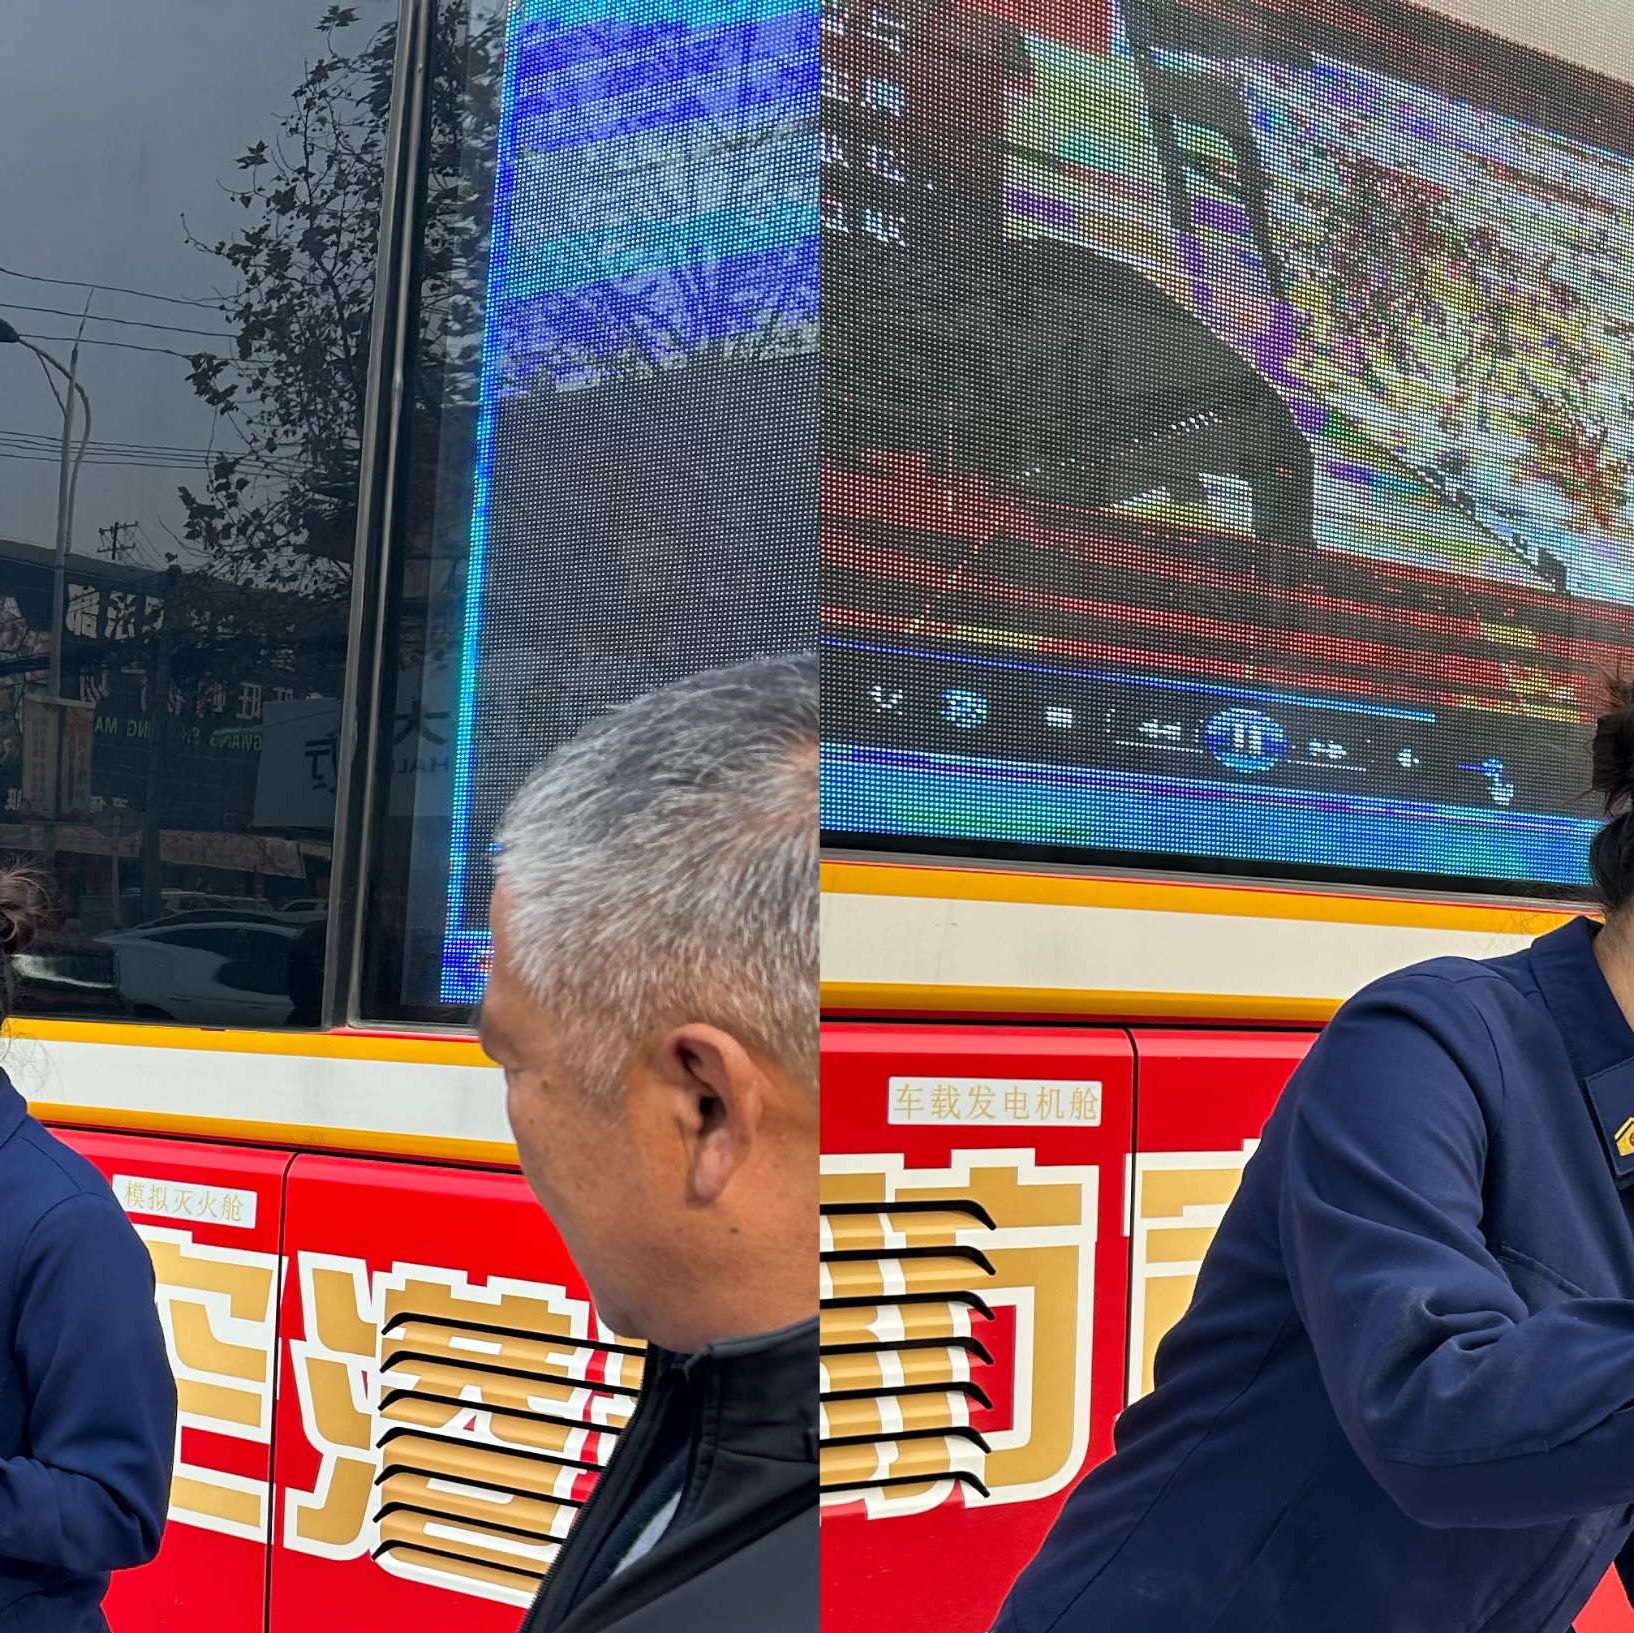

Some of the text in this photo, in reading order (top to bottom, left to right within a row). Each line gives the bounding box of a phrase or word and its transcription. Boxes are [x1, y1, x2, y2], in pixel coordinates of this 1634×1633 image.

[893, 1083, 1100, 1122] 车载发电机舱
[124, 1180, 245, 1222] 模拟灭火舱
